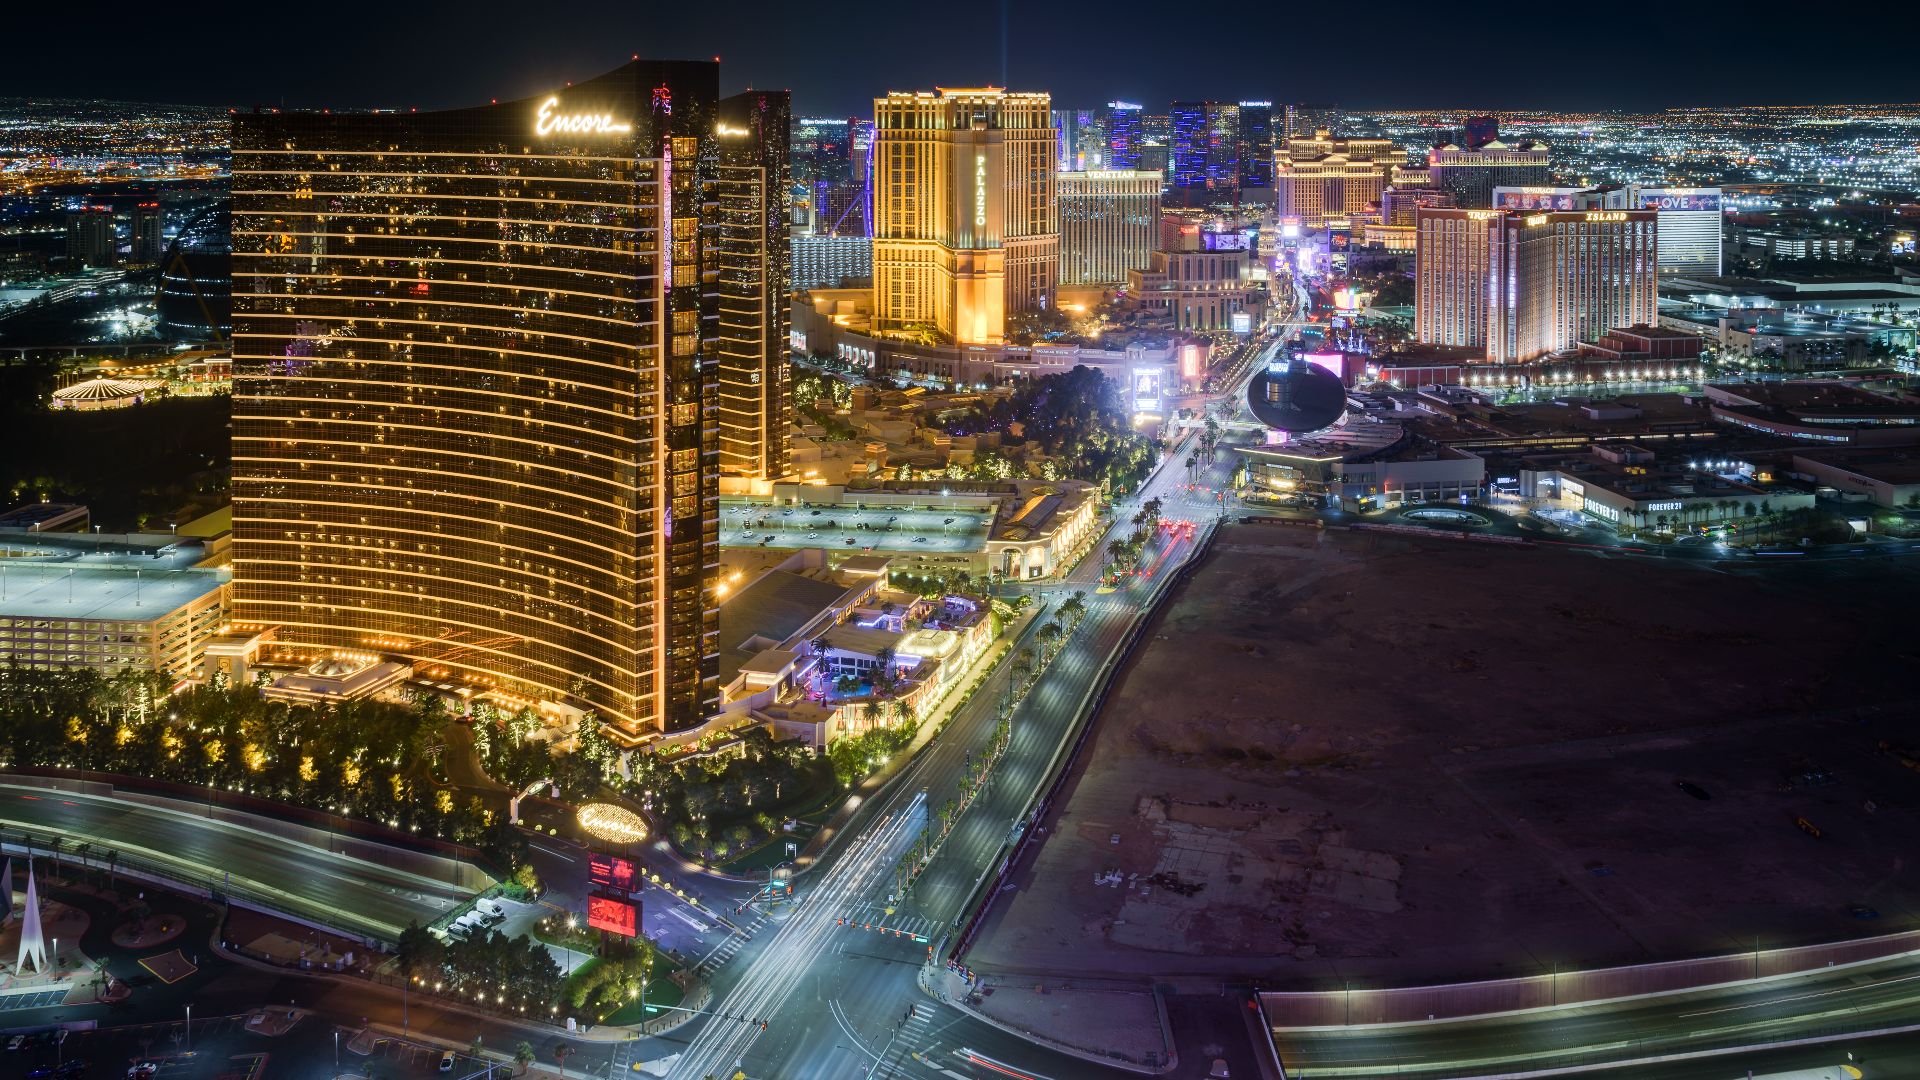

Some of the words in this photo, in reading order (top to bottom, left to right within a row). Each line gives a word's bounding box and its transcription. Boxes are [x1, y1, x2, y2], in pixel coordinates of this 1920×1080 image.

[536, 96, 631, 136] Encore
[1086, 170, 1136, 179] VENETIAN
[976, 156, 985, 225] PALAZZO
[1655, 197, 1689, 209] LOVE
[1586, 212, 1628, 221] ISLAND
[1584, 498, 1610, 518] FOREVER
[1611, 508, 1619, 521] 21
[1648, 502, 1675, 511] FOREVER
[1675, 502, 1682, 510] 21
[581, 807, 647, 836] Encore
